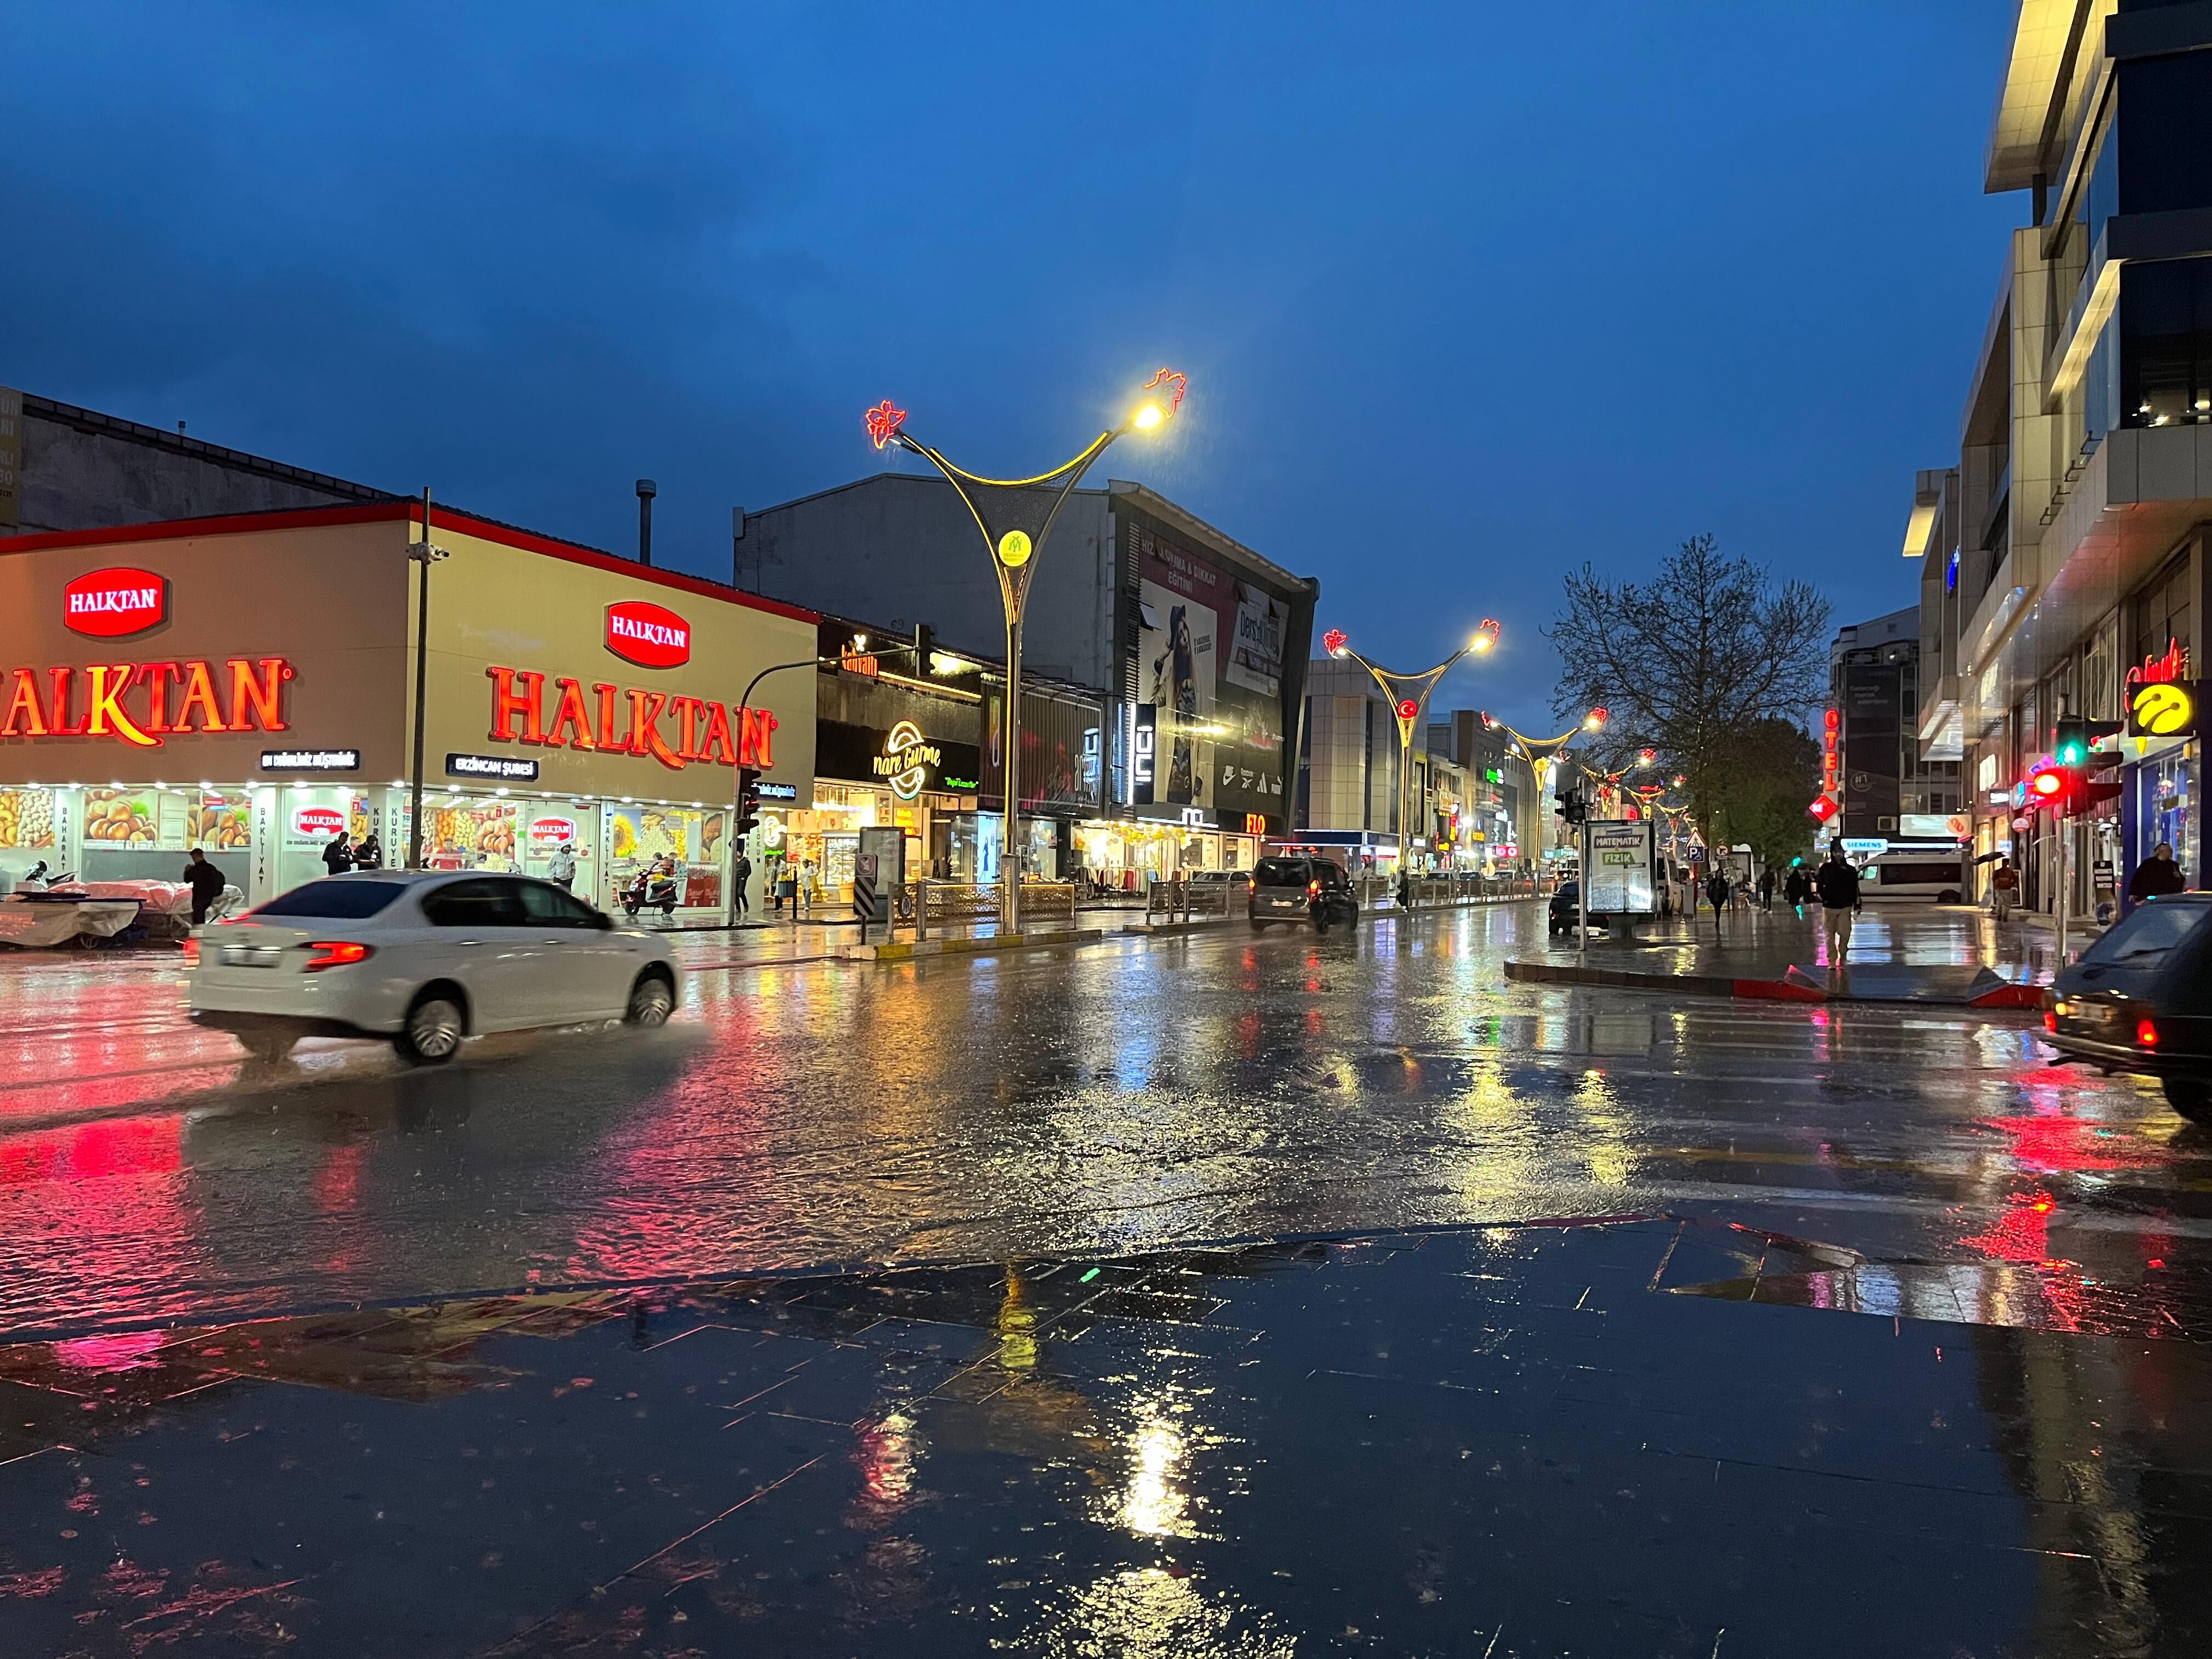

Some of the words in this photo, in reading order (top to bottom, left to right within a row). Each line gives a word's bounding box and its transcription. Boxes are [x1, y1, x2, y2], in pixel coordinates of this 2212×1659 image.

[70, 588, 156, 613] HALKTAN
[612, 616, 685, 648] HALKTAN
[0, 658, 287, 747] ALKTAN
[490, 667, 775, 769] HALKTAN
[1824, 709, 1839, 791] OTEL
[300, 815, 343, 827] HALKTAN
[533, 825, 569, 834] HALKTAN
[1246, 813, 1266, 834] FLO
[1605, 853, 1632, 863] FİZİK
[1689, 847, 1698, 859] P
